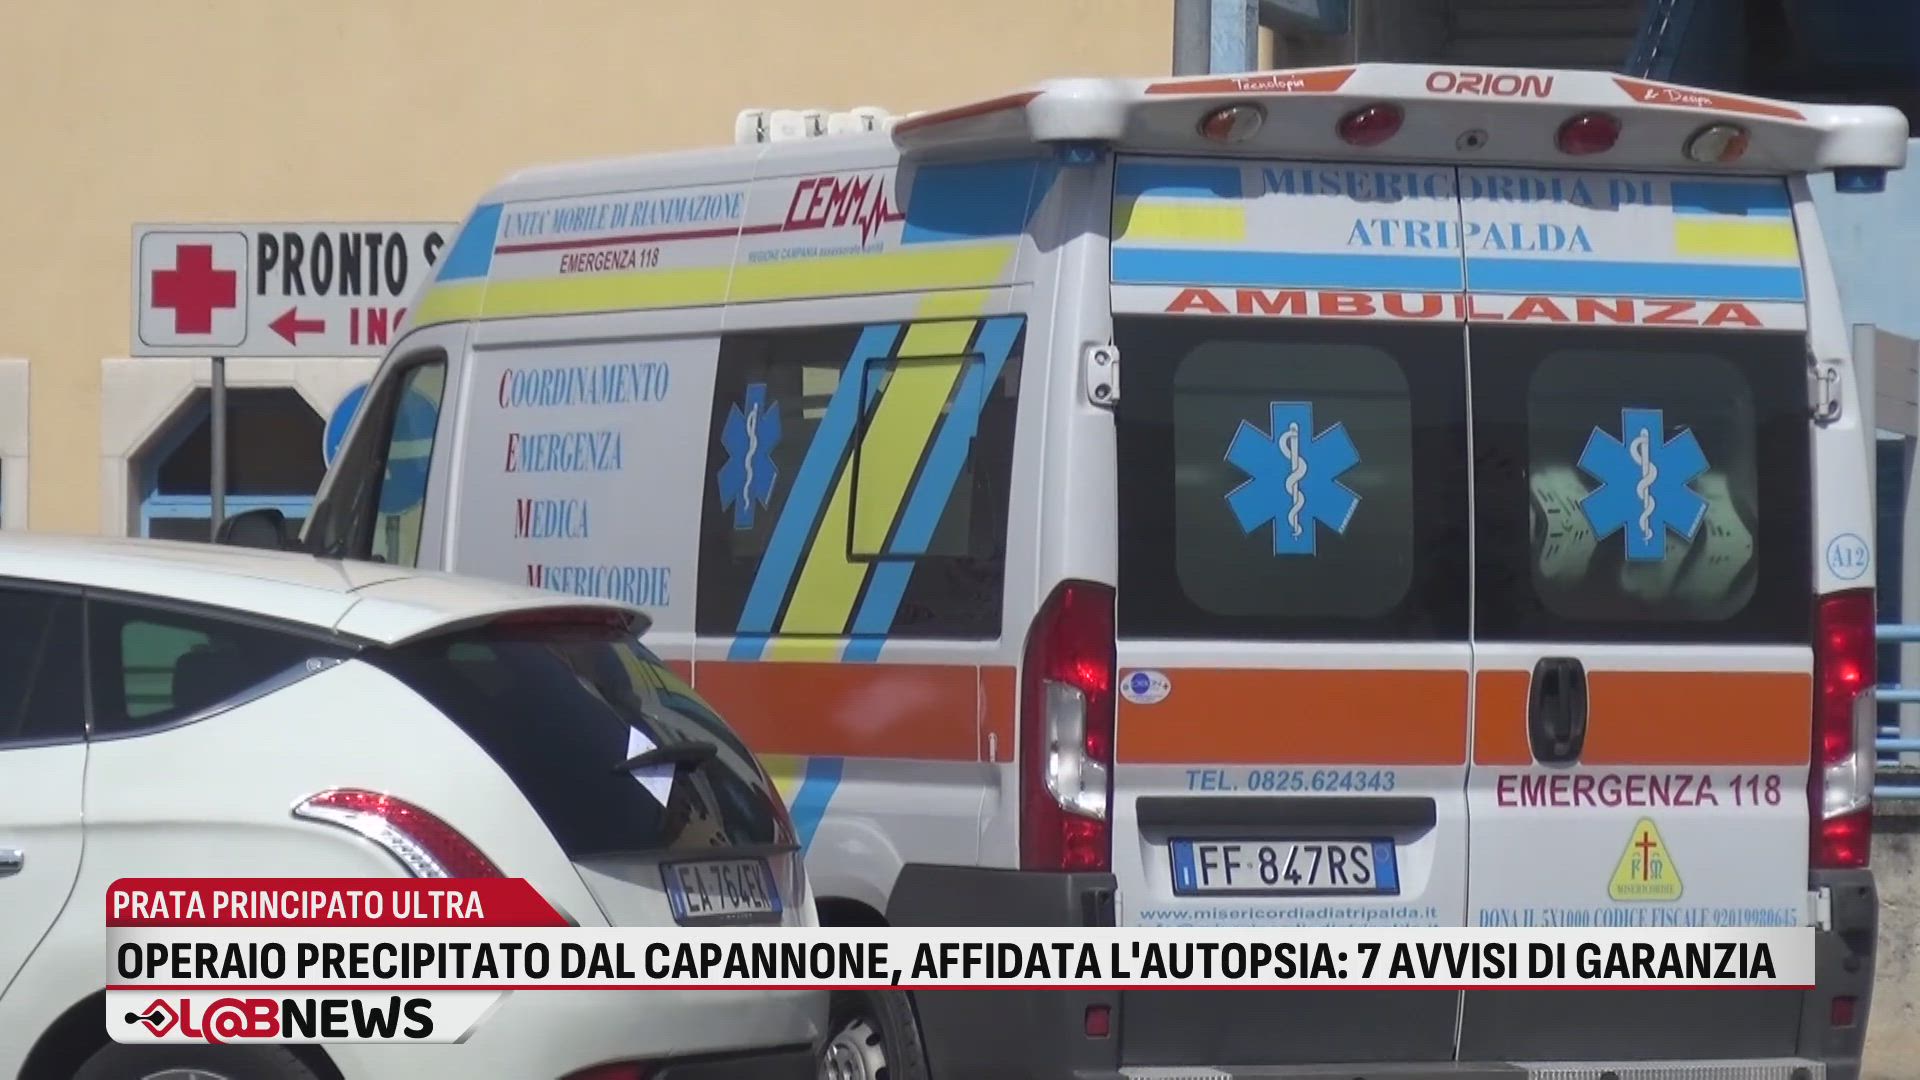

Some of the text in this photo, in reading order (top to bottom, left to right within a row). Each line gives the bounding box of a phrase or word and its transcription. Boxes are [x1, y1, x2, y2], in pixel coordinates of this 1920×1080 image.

[1426, 71, 1553, 97] ORION
[782, 173, 875, 232] CEMM
[1262, 167, 1654, 208] MISERICORDIA DI
[552, 203, 610, 234] MOBILE
[609, 202, 629, 229] DI
[630, 191, 745, 228] RIANIMAZIONE
[1347, 218, 1594, 253] ATRIPALDA
[256, 231, 408, 297] PRONTO
[559, 247, 660, 274] EMERGENZA 118
[1164, 289, 1765, 327] AMBULANZA
[498, 361, 670, 410] COORDINAMENTO
[504, 430, 623, 474] EMERGENZA
[513, 498, 590, 540] MEDICA
[1832, 544, 1865, 568] A12
[527, 564, 672, 607] MISERICORDIE
[1186, 769, 1396, 793] TEL. 0825.624343
[1496, 773, 1782, 808] EMERGENZA 118
[1199, 844, 1372, 886] FF 847RS
[678, 866, 712, 912] EA
[1139, 906, 1438, 922] www.misericordiadiatripalda.it
[1479, 907, 1518, 927] DONA
[1541, 908, 1590, 927] 5X1000
[1593, 907, 1649, 927] CODICE
[1651, 907, 1710, 927] FISCALE
